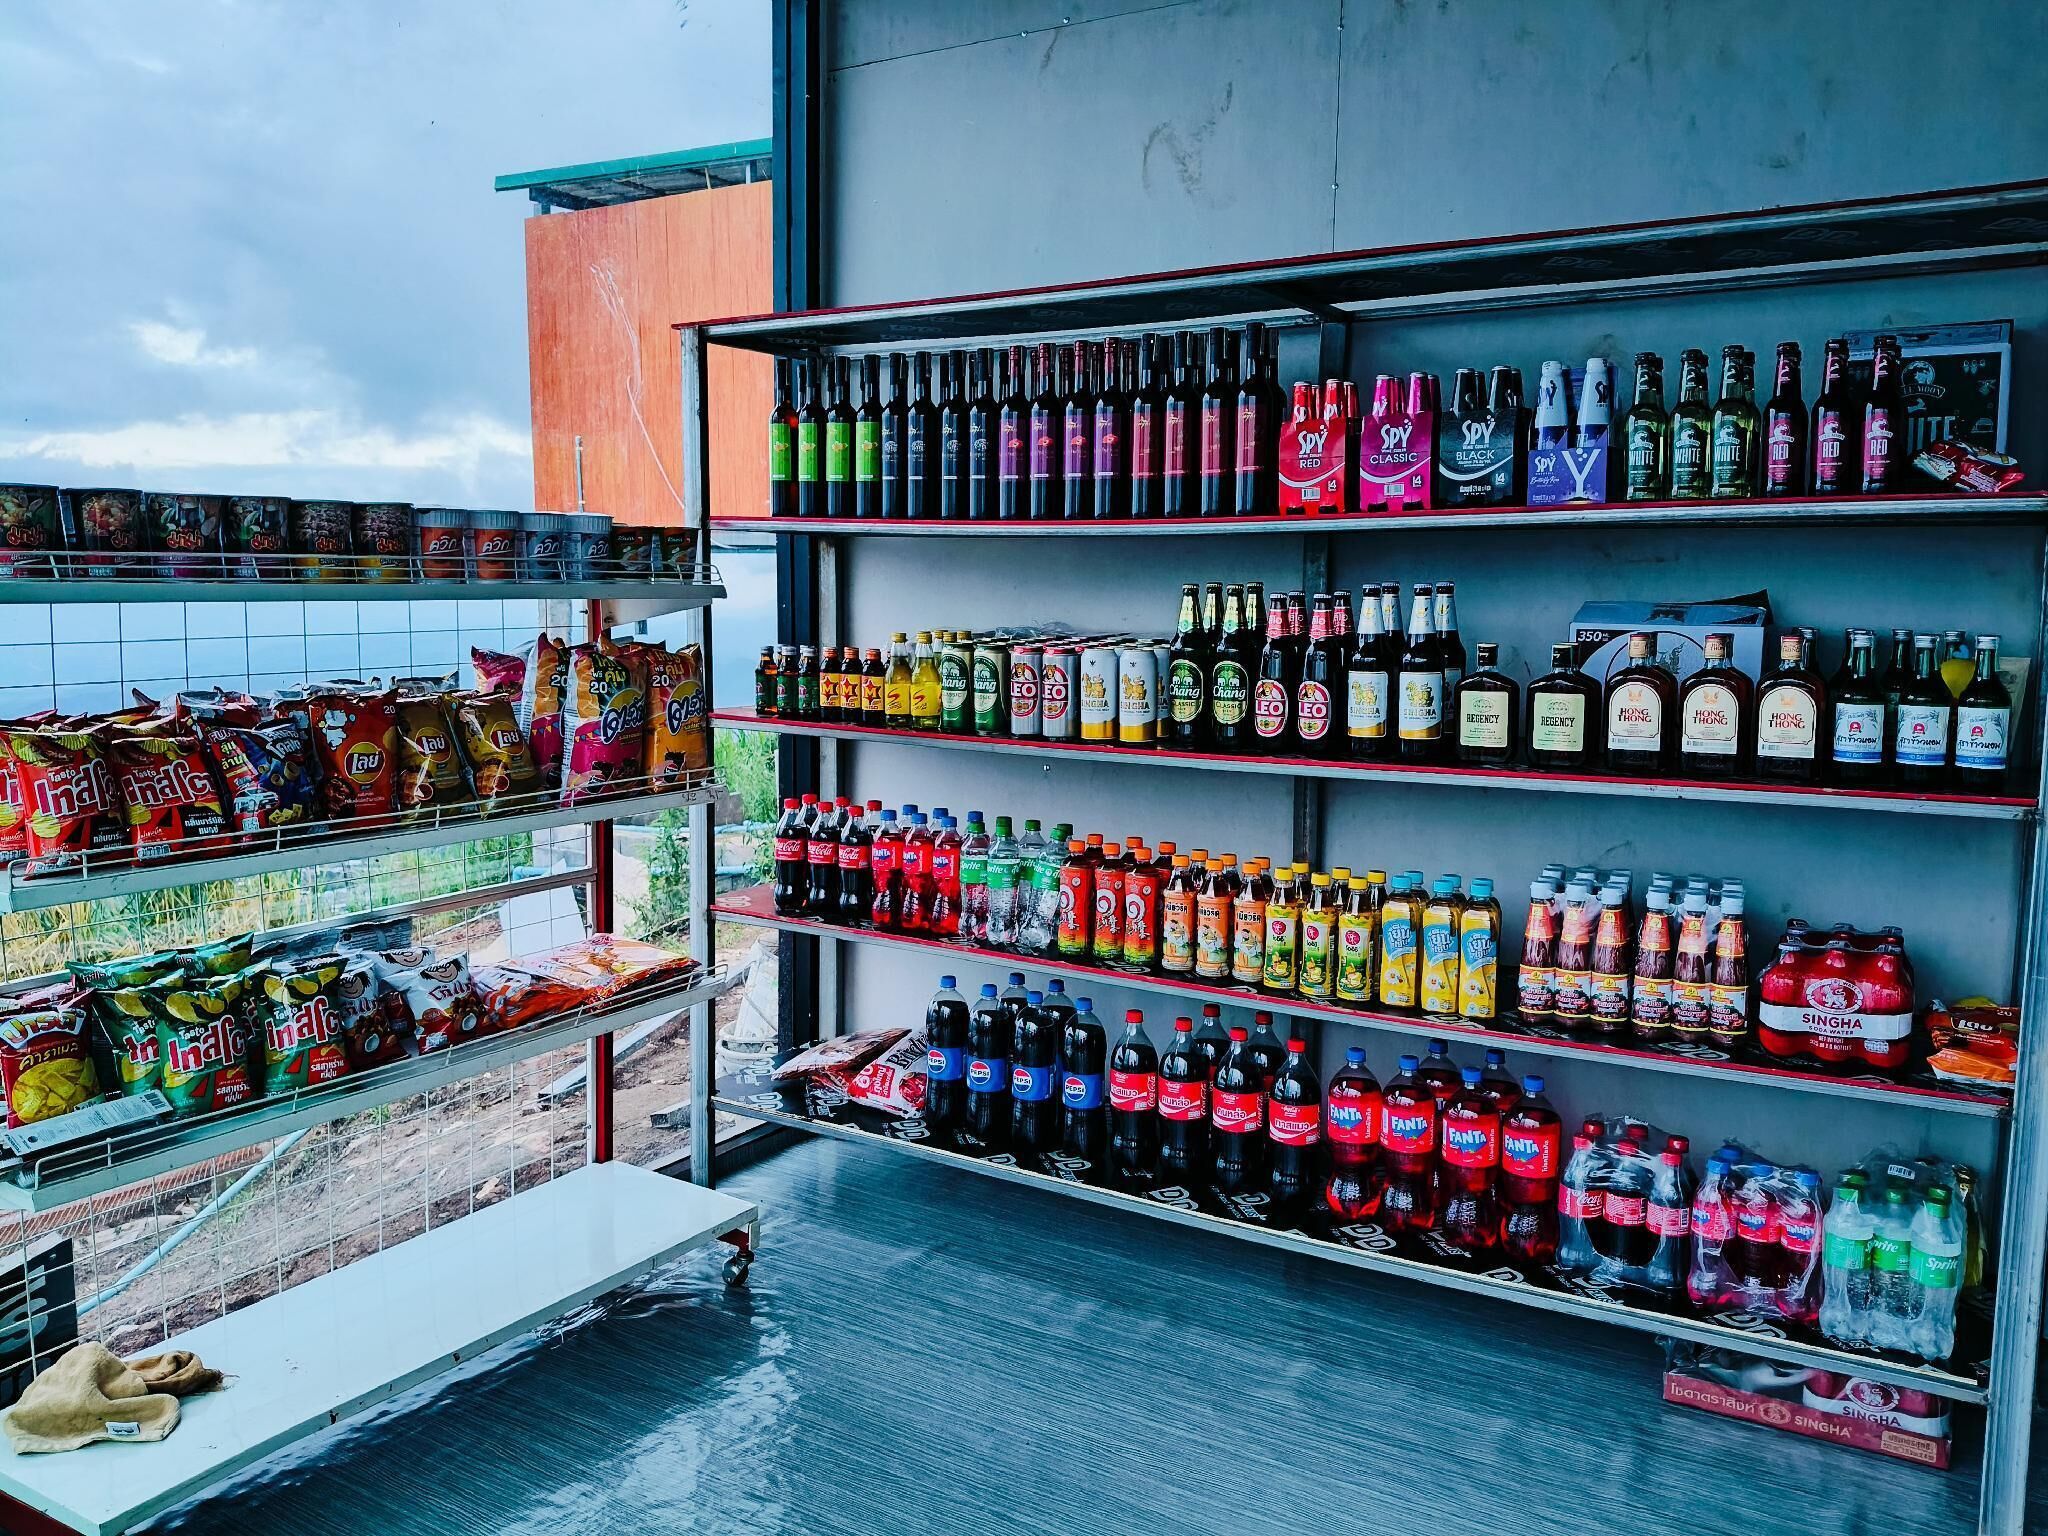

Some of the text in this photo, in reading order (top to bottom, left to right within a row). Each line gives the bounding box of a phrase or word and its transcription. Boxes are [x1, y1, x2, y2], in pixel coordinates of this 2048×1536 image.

[1381, 423, 1412, 449] SPY
[1461, 419, 1495, 446] SPY
[1298, 431, 1328, 455] SPY
[1823, 441, 1839, 458] RED
[1870, 439, 1888, 456] RED
[1370, 453, 1418, 464] CLASSIC
[1456, 450, 1495, 461] BLACK
[1629, 450, 1654, 466] WHITE
[1675, 448, 1700, 464] WHITE
[1715, 445, 1740, 462] WHITE
[1772, 444, 1789, 461] RED
[1300, 459, 1321, 469] RED
[1535, 456, 1556, 472] SPY
[1561, 449, 1601, 498] Y
[429, 535, 457, 553] ควิก
[482, 535, 513, 553] ควิก
[1577, 631, 1603, 642] 350
[593, 669, 603, 679] ฟรี
[654, 664, 665, 673] ฟรี
[666, 661, 685, 680] คุ้ม
[551, 675, 568, 687] 20
[590, 682, 608, 694] 20
[652, 674, 670, 688] 20
[974, 678, 998, 692] hang
[1170, 683, 1200, 699] Chang
[1213, 685, 1246, 700] Chang
[383, 705, 396, 715] 20
[1255, 701, 1284, 716] LEO
[1299, 702, 1327, 716] LEO
[1350, 706, 1380, 715] SINGHA
[1404, 708, 1437, 718] SINGHA
[1620, 707, 1649, 716] HONG
[1695, 709, 1725, 719] HONG
[1466, 714, 1500, 724] REGENCY
[1540, 716, 1576, 728] REGENCY
[1617, 714, 1652, 723] THONG
[1692, 716, 1728, 726] THONG
[1771, 712, 1803, 722] HONG
[1768, 720, 1806, 730] THONG
[422, 733, 446, 754] เลย์
[498, 728, 520, 748] เลย์
[351, 751, 380, 774] เลย์
[1997, 1009, 2013, 1017] 20
[1802, 1013, 1863, 1030] SINGHA
[179, 1026, 205, 1041] Tasto
[1808, 1025, 1828, 1034] SODA
[18, 1042, 79, 1071] คาราเมล
[970, 1069, 990, 1078] PEPSI
[1014, 1077, 1031, 1086] PEPSI
[1065, 1085, 1085, 1094] PEPSI
[1161, 1095, 1191, 1107] คนหล่อ
[1216, 1107, 1248, 1120] คนหล่อ
[1330, 1104, 1362, 1121] FANTA
[1391, 1116, 1428, 1131] FANTA
[1449, 1128, 1487, 1145] FANTA
[1504, 1135, 1540, 1154] FANTA
[1671, 1382, 1756, 1416] โซดาตราสิงห์
[1842, 1405, 1901, 1428] SINGHA
[1795, 1415, 1852, 1438] SINGHA
